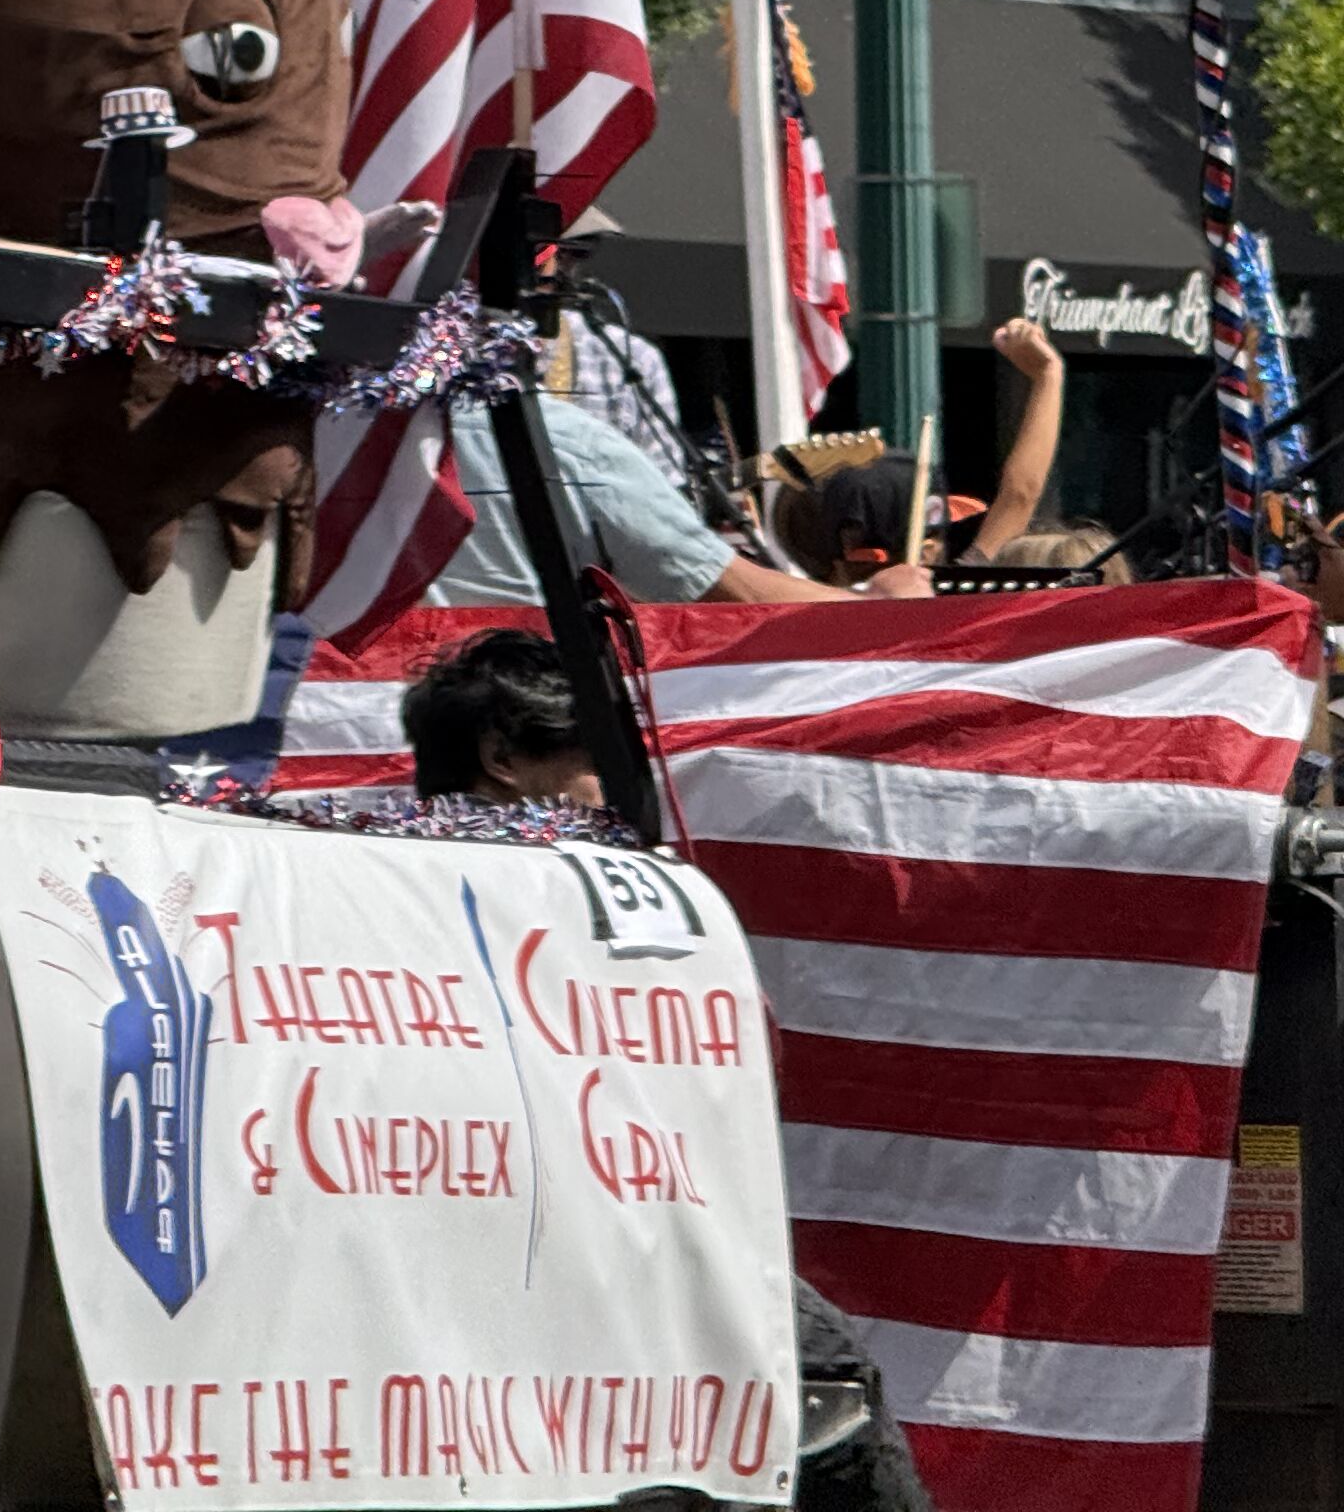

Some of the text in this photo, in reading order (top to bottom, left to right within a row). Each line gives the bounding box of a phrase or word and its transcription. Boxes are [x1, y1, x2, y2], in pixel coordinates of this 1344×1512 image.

[592, 855, 665, 913] 53
[193, 911, 743, 1068] THEATRE CINEMA
[294, 1065, 514, 1198] CINEPLEX
[90, 1372, 775, 1490] AKE THE MAGIC WITH YOU
